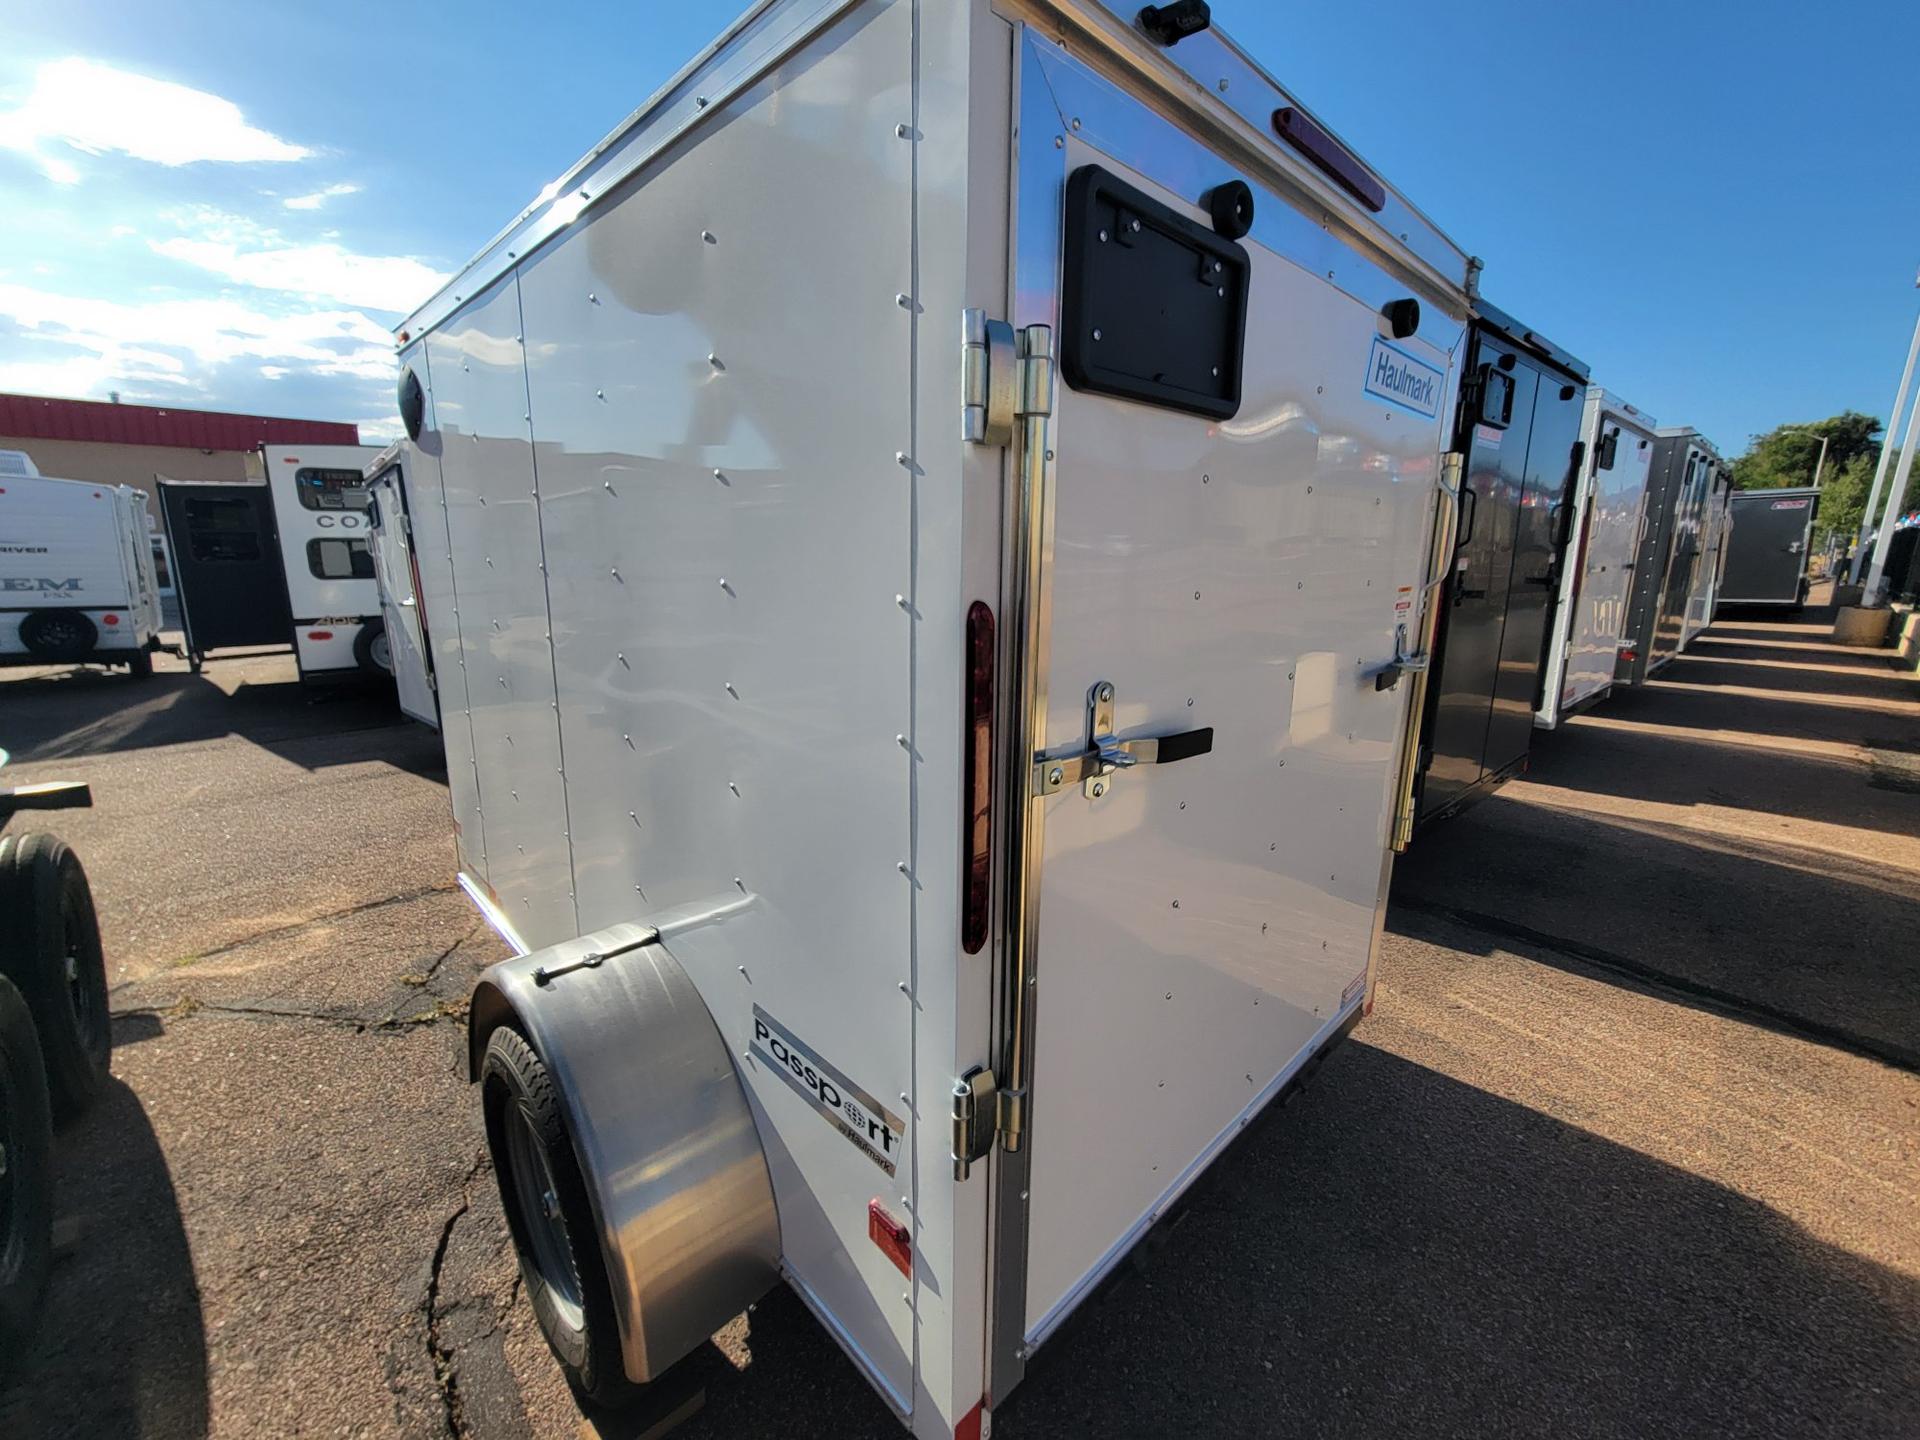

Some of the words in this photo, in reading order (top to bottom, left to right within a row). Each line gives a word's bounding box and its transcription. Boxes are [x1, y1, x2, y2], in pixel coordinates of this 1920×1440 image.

[1375, 352, 1433, 406] Haulmark
[754, 1018, 893, 1153] Passport
[847, 1129, 891, 1172] Haulmark
